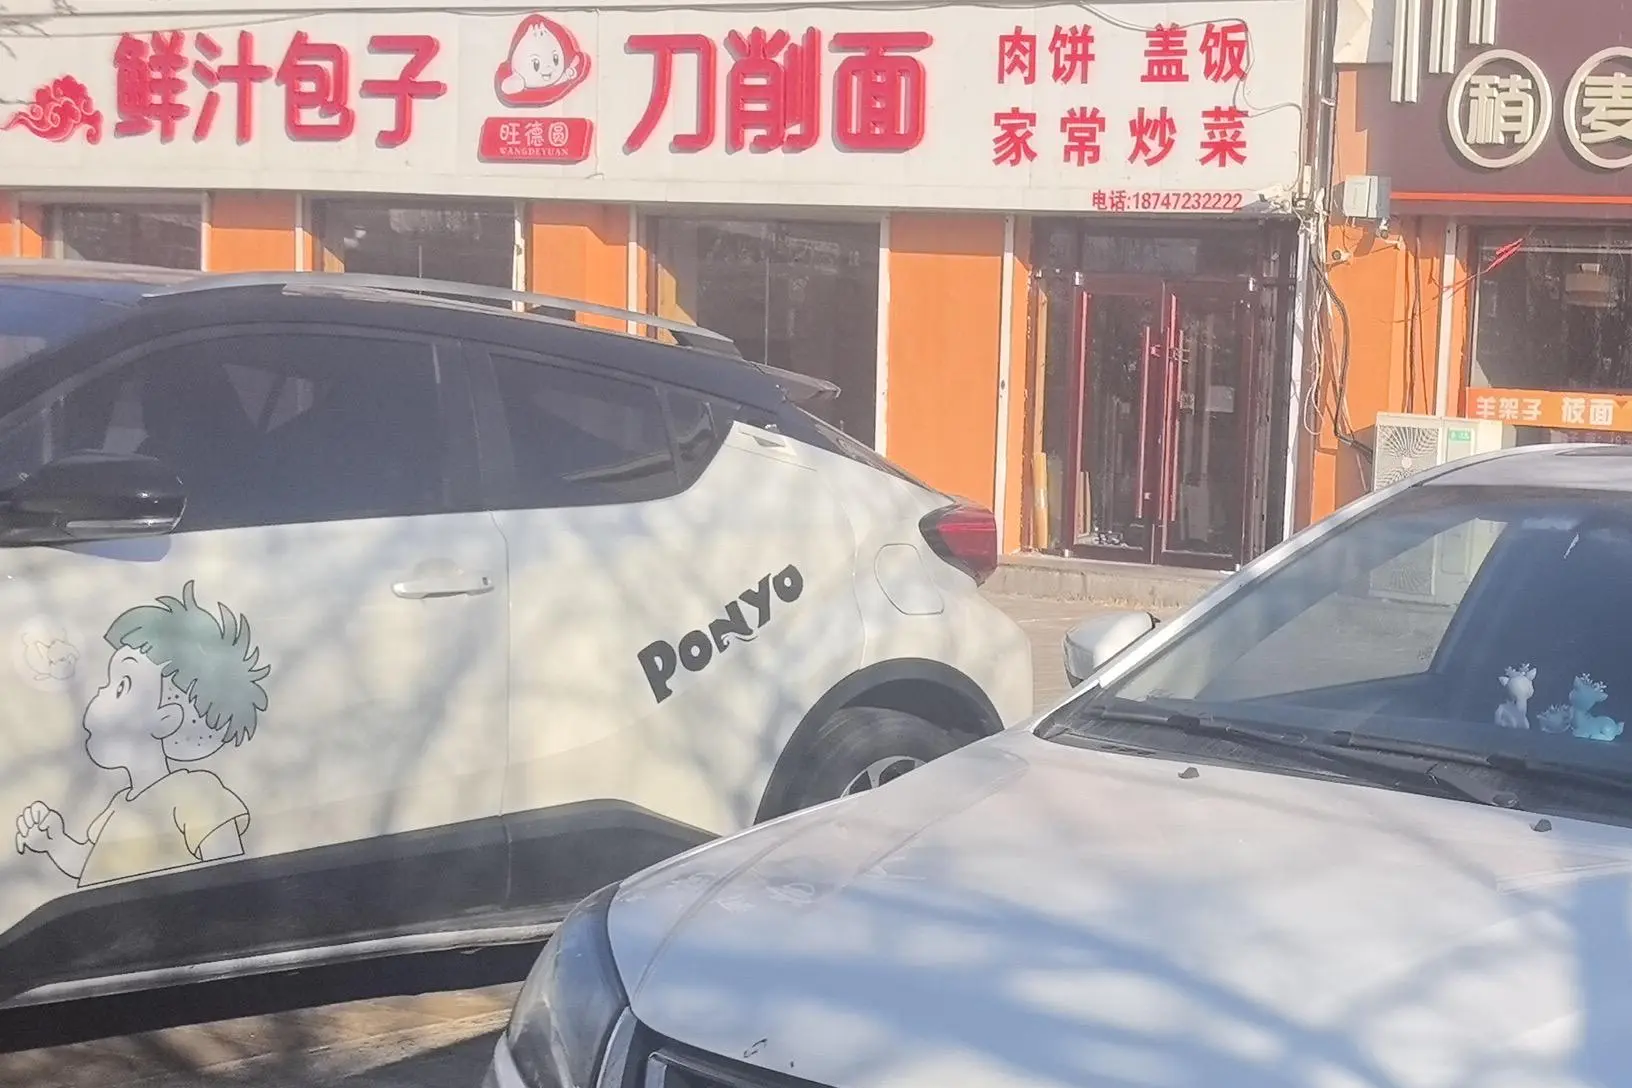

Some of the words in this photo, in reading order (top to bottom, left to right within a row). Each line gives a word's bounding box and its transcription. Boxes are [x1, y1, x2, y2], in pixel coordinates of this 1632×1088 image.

[997, 24, 1096, 84] 肉饼
[1140, 23, 1249, 83] 盖饭
[115, 30, 447, 147] 鲜汁包子
[626, 26, 933, 154] 刀削面
[499, 121, 569, 147] 旺德圆
[499, 147, 569, 157] WANGDEYUAN
[991, 106, 1249, 168] 家常炒菜
[1091, 189, 1243, 212] 电话:18747232222
[1475, 395, 1543, 421] 羊架子
[637, 564, 804, 704] PONYO
